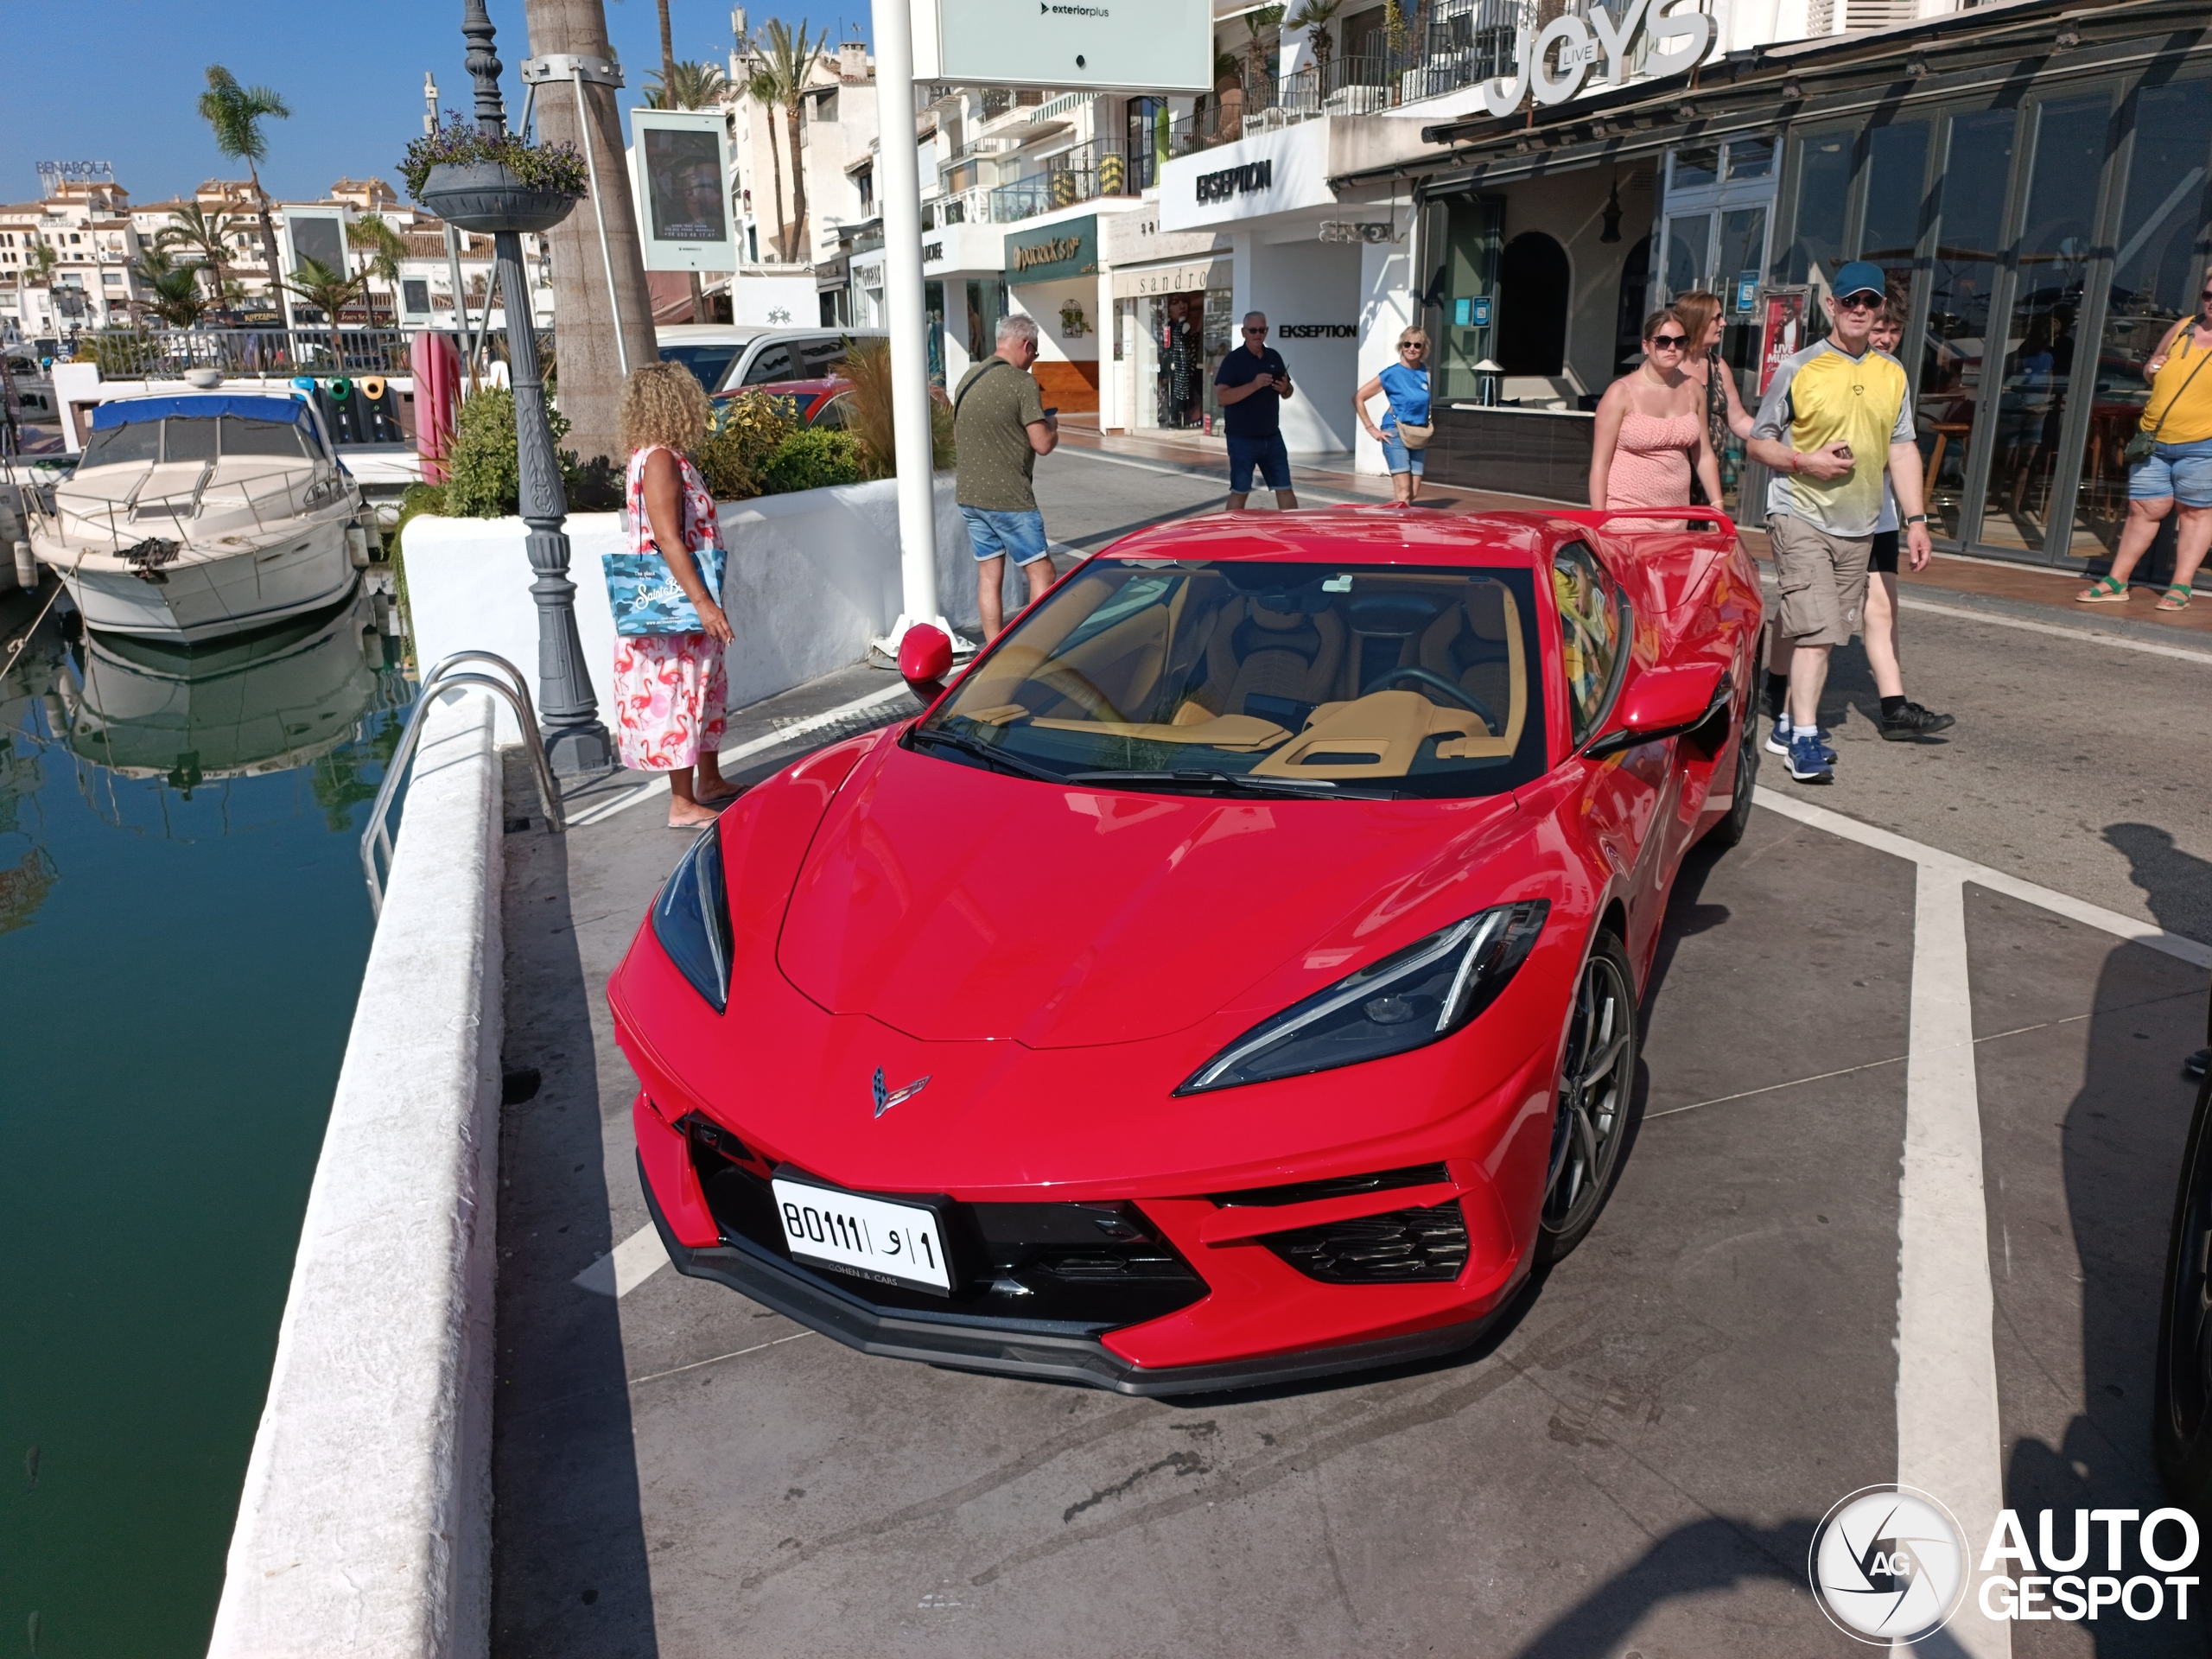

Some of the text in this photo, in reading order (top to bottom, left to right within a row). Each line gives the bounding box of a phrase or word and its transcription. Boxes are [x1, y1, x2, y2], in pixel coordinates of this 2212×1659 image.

[1052, 5, 1109, 17] exteriorplus
[1483, 0, 1712, 118] JOYS
[1563, 45, 1592, 65] LIVE
[35, 161, 112, 174] BENABOLA
[1197, 159, 1272, 201] EKSEPTION
[862, 264, 880, 287] GUESS
[1140, 268, 1206, 293] sandro
[1279, 325, 1357, 338] EKSEPTION
[1773, 343, 1795, 354] LIVE
[635, 583, 664, 610] Saint
[783, 1202, 863, 1252] 80111
[881, 1230, 901, 1255] و
[920, 1232, 935, 1269] 1
[829, 1263, 860, 1278] COHEN
[874, 1274, 898, 1287] CARS
